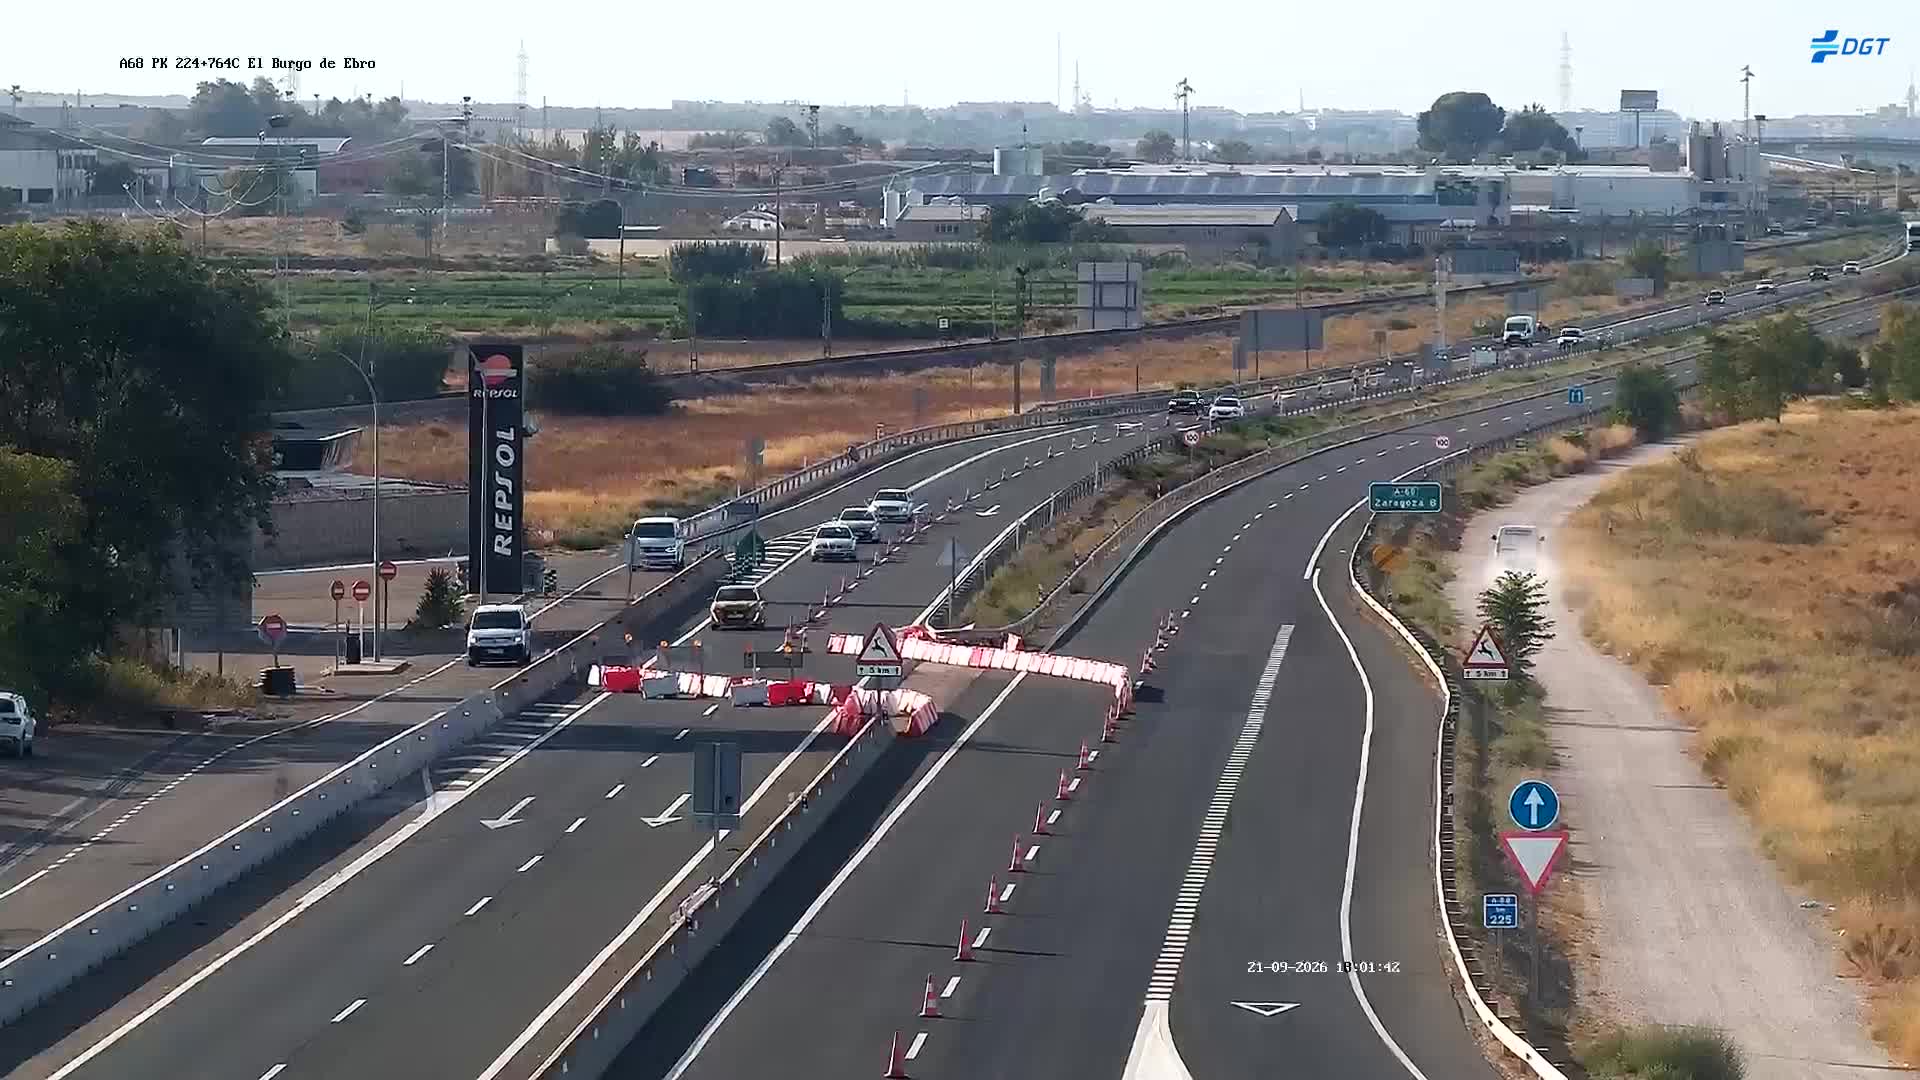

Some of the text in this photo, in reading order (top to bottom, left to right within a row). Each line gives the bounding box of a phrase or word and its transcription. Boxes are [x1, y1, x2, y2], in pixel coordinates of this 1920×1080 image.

[494, 427, 515, 556] REPSOL
[1375, 498, 1425, 509] Zaragoza
[1490, 914, 1512, 925] 225
